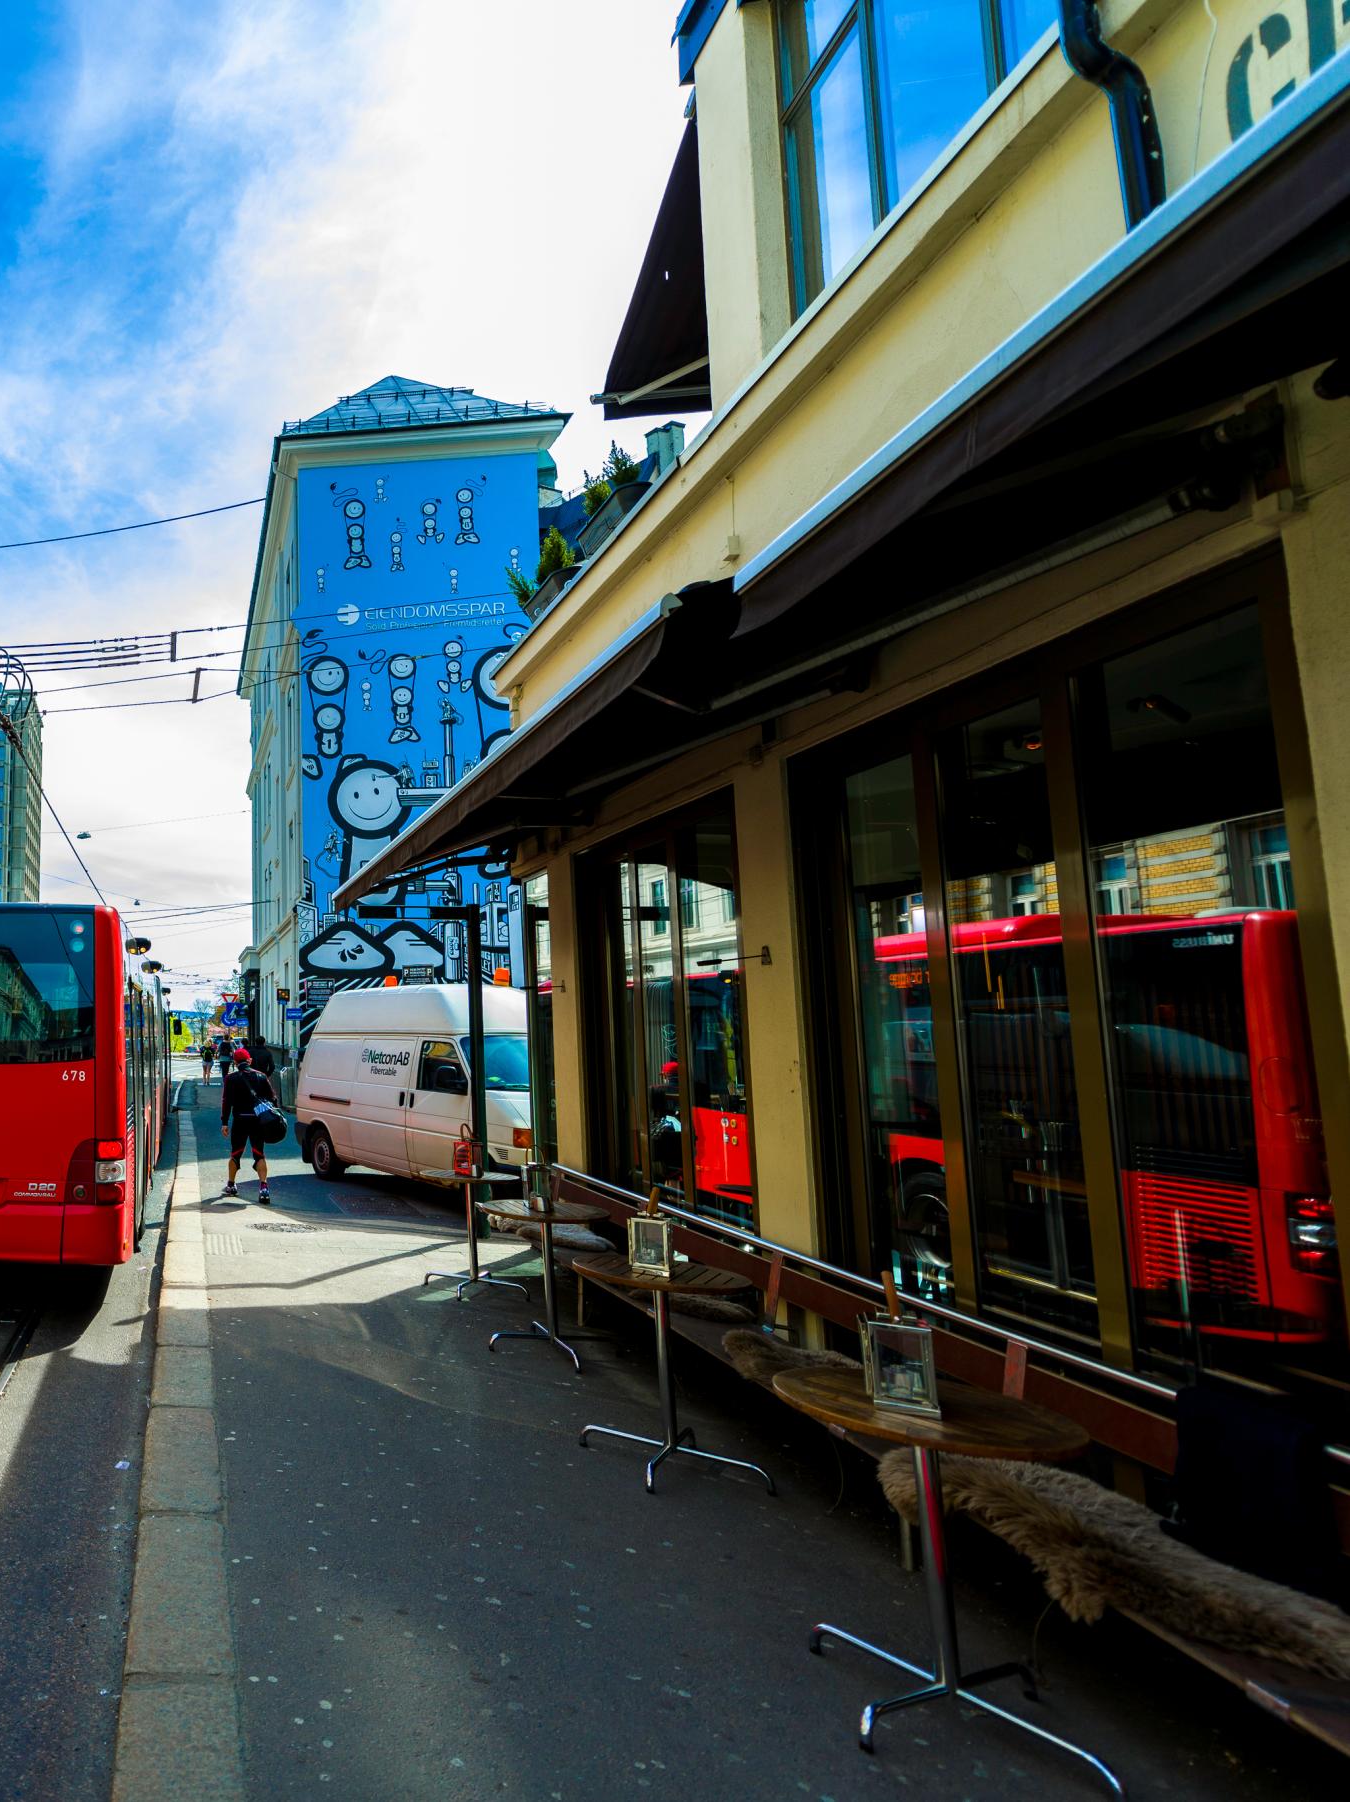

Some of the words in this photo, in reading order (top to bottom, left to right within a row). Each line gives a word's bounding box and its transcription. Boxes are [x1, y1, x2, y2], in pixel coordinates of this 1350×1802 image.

[364, 602, 505, 620] EIENDOMSSPAR
[368, 1050, 410, 1066] NetconAB
[62, 1070, 85, 1081] 678
[370, 1066, 397, 1076] Fibercable
